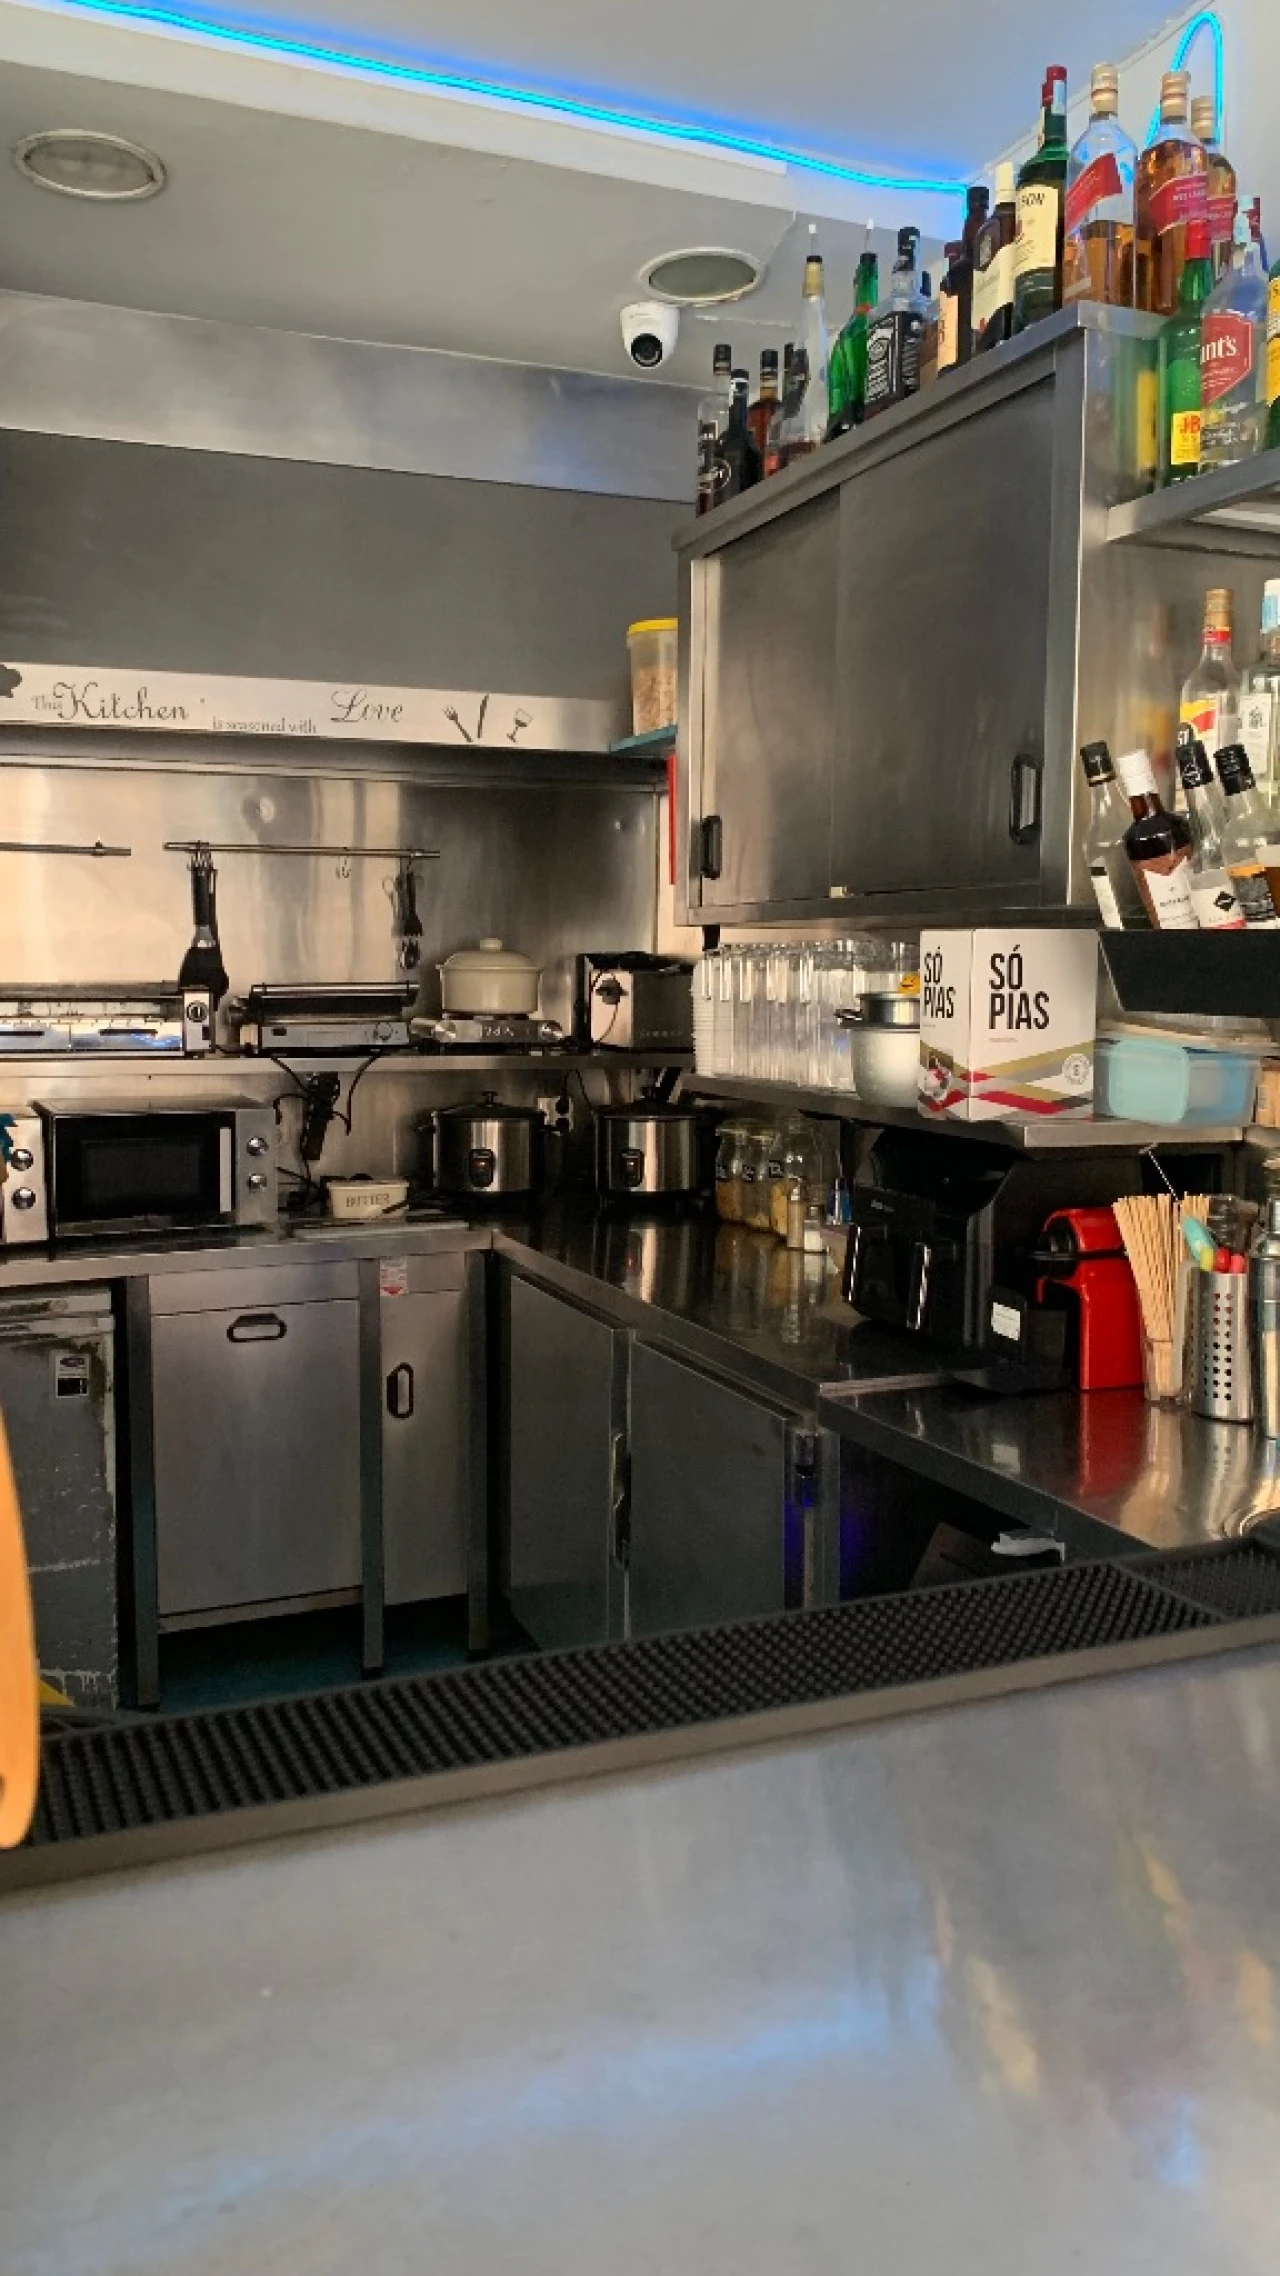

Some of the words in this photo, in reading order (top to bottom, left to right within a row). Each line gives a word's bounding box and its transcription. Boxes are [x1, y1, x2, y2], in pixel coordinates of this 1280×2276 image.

[52, 681, 189, 720] Kitchen
[213, 715, 223, 730] is
[226, 717, 285, 732] seasoned
[288, 718, 316, 734] with
[330, 688, 403, 723] Love
[923, 946, 943, 984] SÓ
[988, 944, 1024, 991] SÓ
[923, 986, 956, 1019] PIAS
[988, 991, 1051, 1030] PIAS
